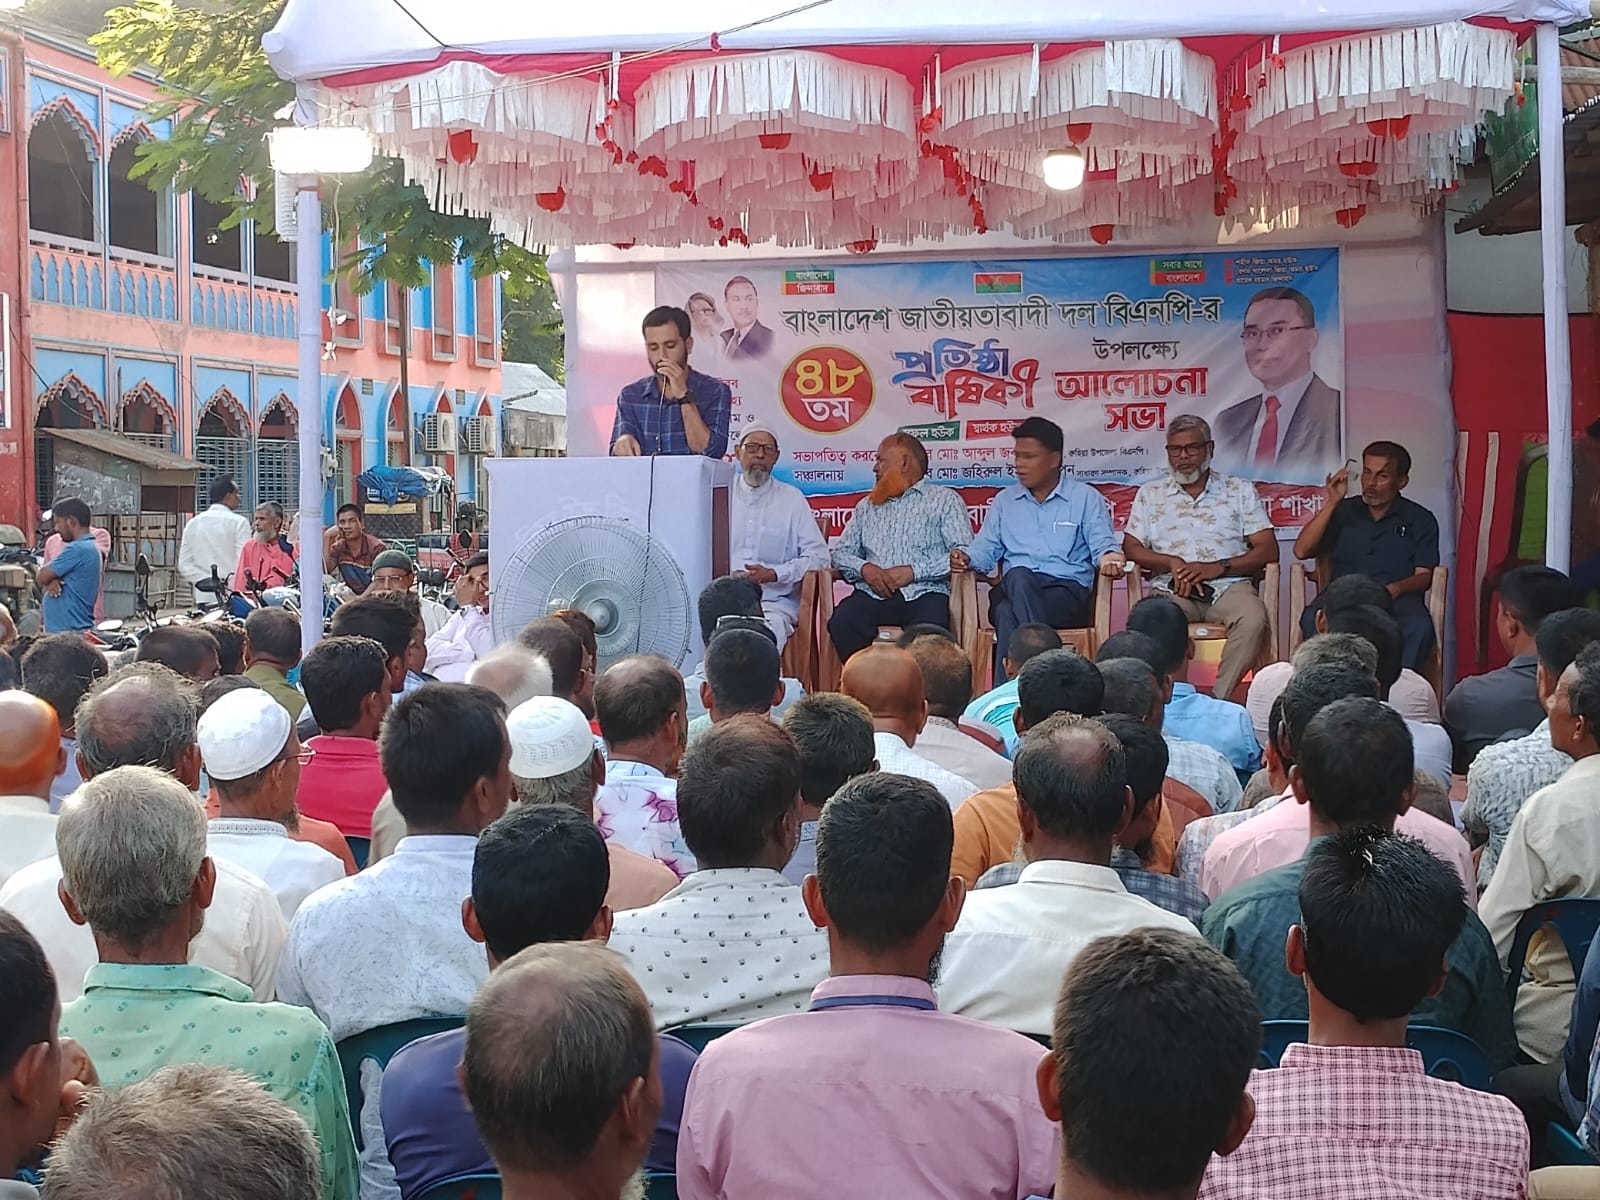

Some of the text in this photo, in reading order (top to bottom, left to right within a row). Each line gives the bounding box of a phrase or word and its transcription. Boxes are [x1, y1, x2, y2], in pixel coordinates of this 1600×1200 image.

[783, 306, 891, 333] বাংলাদেশ
[899, 295, 1051, 330] জাতীয়তাবাদী
[1058, 302, 1099, 327] দল
[892, 337, 1009, 384] প্রতিষ্ঠা
[795, 358, 864, 396] ৪৮
[903, 358, 1208, 420] বার্ষিকী আলোচনা
[801, 397, 853, 423] তম
[1103, 402, 1168, 430] সভা
[999, 420, 1018, 433] হউ
[793, 447, 847, 465] সভাপতিত্ব
[937, 448, 958, 460] মোঃ
[962, 447, 996, 462] আব্দুল
[794, 470, 844, 482] সঞ্চালনায়
[937, 467, 957, 479] মোঃ
[961, 463, 1003, 479] জহিরুল
[1280, 493, 1324, 518] শাখা
